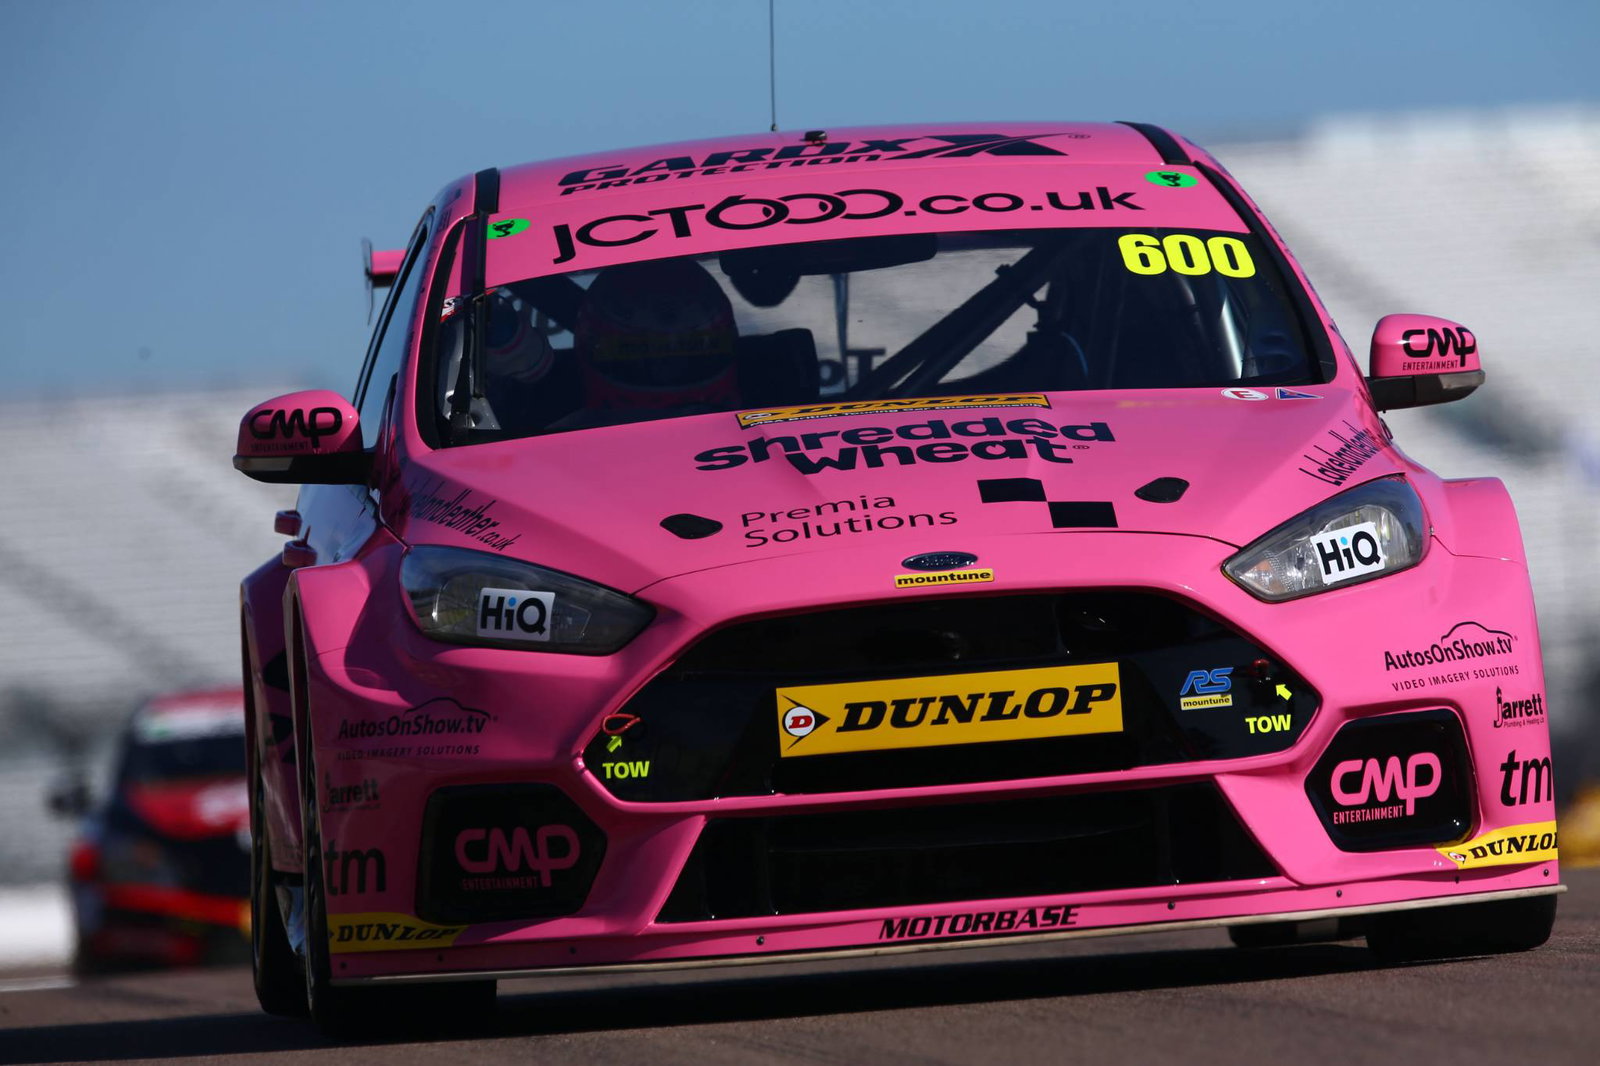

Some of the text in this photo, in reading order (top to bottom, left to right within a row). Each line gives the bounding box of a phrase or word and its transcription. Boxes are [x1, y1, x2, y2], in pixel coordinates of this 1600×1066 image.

[560, 154, 881, 196] PROTECTION
[553, 186, 1146, 265] JCT600.co.uk
[1118, 234, 1256, 278] 600
[1402, 327, 1476, 367] CMP
[1402, 360, 1458, 371] ENTERTAINMENT
[249, 407, 342, 448] CMP
[694, 417, 1116, 471] shredded
[785, 436, 1073, 475] wheat
[741, 495, 896, 527] Premia
[744, 511, 958, 547] Solutions
[1316, 531, 1381, 575] HiQ
[897, 572, 991, 585] mountune
[480, 595, 547, 636] HiQ
[1384, 637, 1513, 671] AutosOnShow.tv
[1180, 667, 1234, 695] RS
[1392, 665, 1519, 692] VIDEO IMAGERY SOLUTIONS
[836, 683, 1117, 733] DUNLOP
[1182, 696, 1230, 708] mountune
[338, 715, 487, 741] AutosOnShow.tv
[1245, 714, 1291, 734] TOW
[417, 744, 480, 756] SOLUTIONS
[602, 761, 650, 779] TOW
[1330, 752, 1442, 815] CMP
[1500, 750, 1552, 807] tm
[1333, 805, 1404, 824] ENTERTAINMENT
[324, 840, 387, 896] tm
[455, 824, 581, 887] CMP
[462, 876, 538, 890] ENTERTAINMENT
[336, 923, 459, 942] DUNLOP
[878, 905, 1079, 940] MOTORBASE
